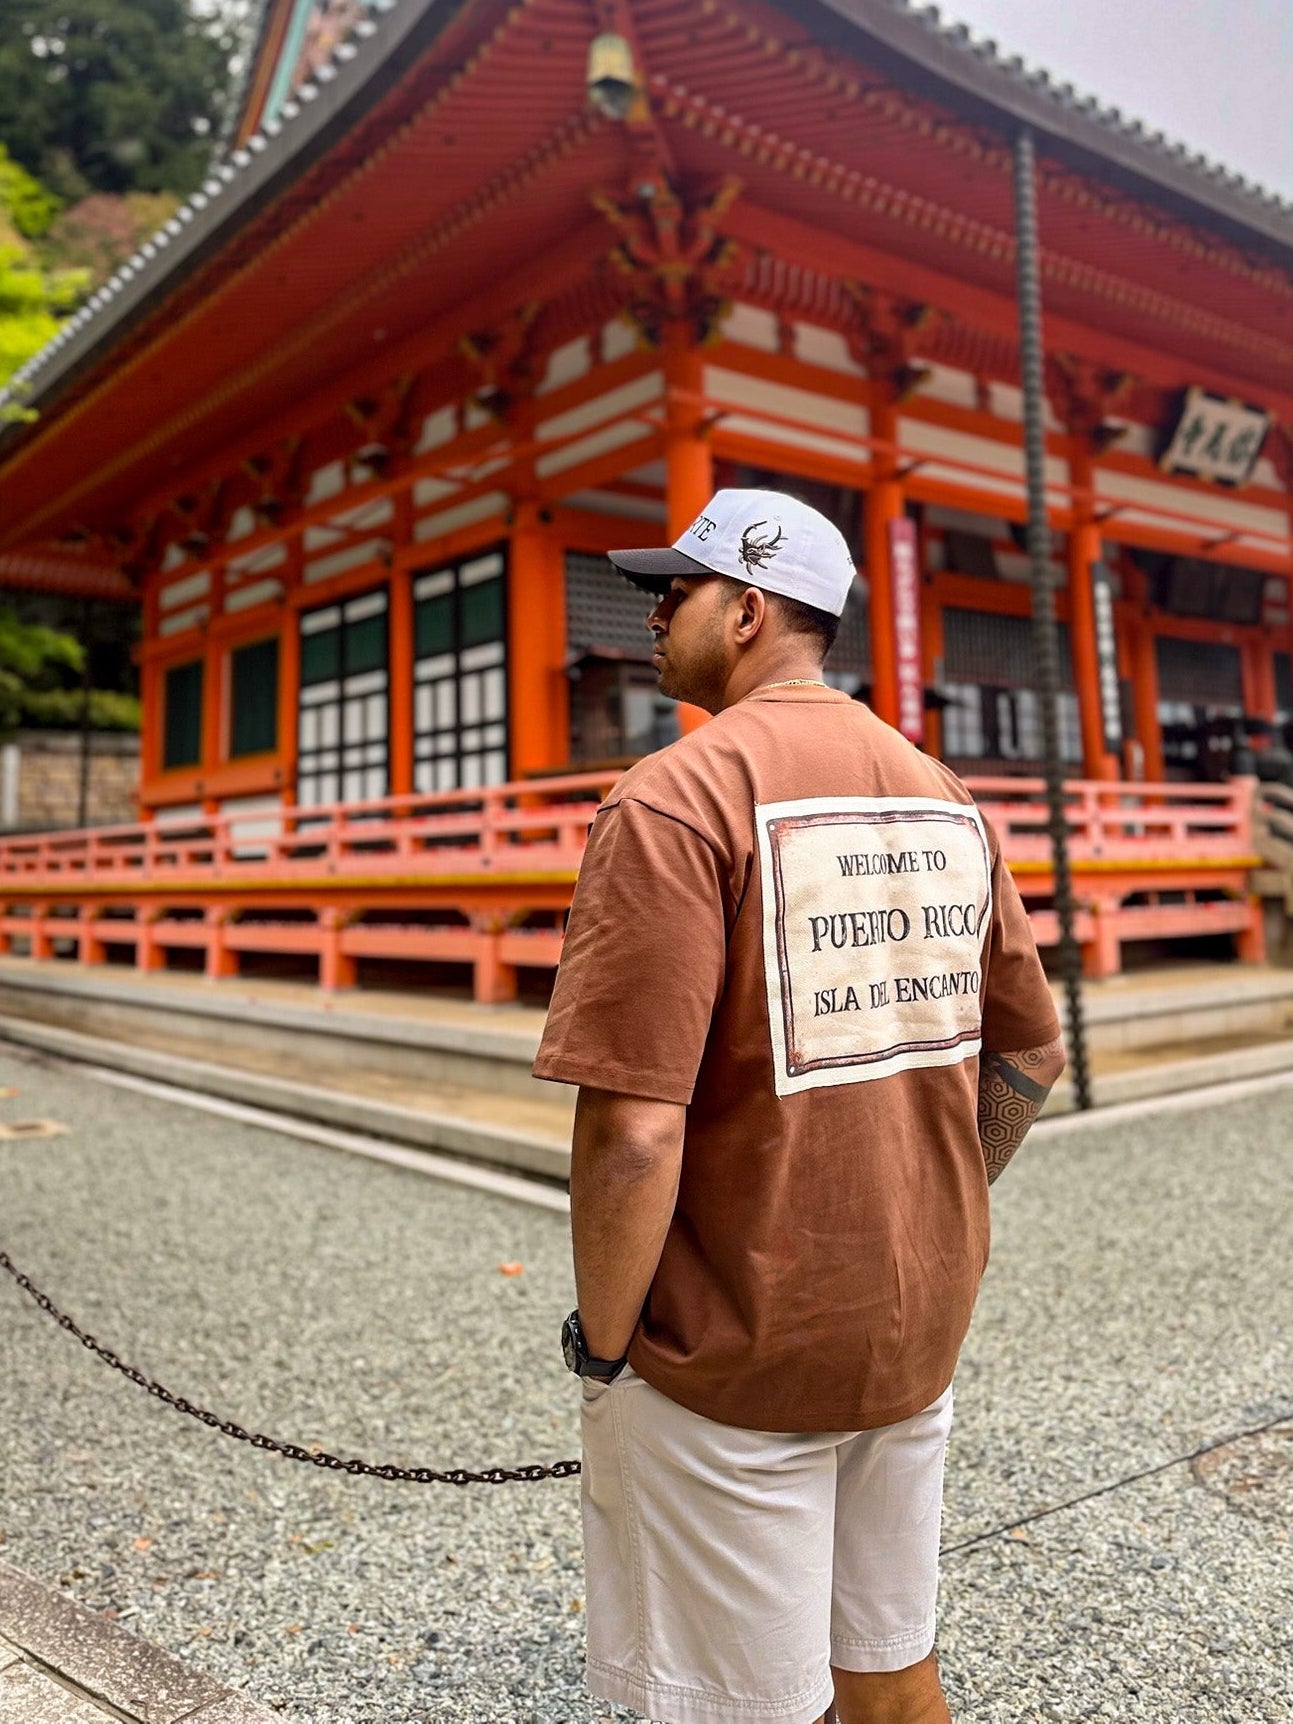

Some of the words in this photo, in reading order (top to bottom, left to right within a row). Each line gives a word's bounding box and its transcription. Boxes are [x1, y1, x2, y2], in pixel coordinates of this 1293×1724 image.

[836, 851, 920, 877] WELCOME
[922, 849, 947, 872] TO
[808, 908, 911, 953] PUERTO
[921, 903, 976, 940] RICO
[813, 986, 862, 1017] ISLA
[868, 981, 890, 1009] DEL
[894, 970, 979, 1003] ENCANTO
